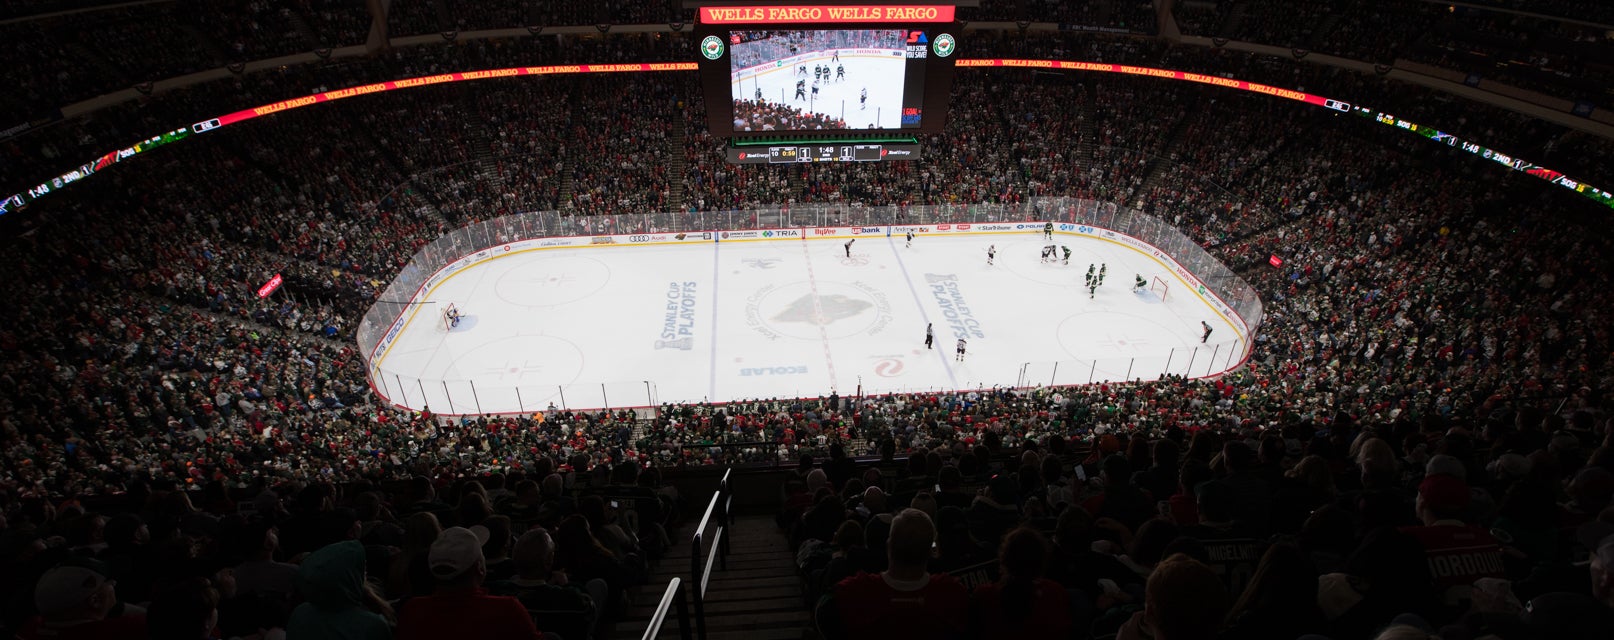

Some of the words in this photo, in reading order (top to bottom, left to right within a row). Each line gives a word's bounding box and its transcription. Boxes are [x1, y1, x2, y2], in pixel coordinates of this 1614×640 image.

[709, 8, 765, 21] WELLS
[768, 8, 822, 20] FARGO
[827, 8, 883, 20] WELLS
[885, 8, 938, 20] FARGO
[461, 71, 490, 79] WELLS
[490, 69, 518, 77] FARGO
[1120, 66, 1147, 74] WELLS
[1147, 69, 1175, 77] FARGO
[393, 78, 424, 88] WELLS
[424, 75, 453, 84] FARGO
[1183, 73, 1211, 83] WELLS
[1211, 78, 1239, 87] FARGO
[324, 89, 356, 99] WELLS
[356, 84, 385, 94] FARGO
[1248, 84, 1276, 94] WELLS
[1276, 89, 1305, 100] FARGO
[253, 103, 286, 115] WELLS
[286, 96, 316, 108] FARGO
[1397, 120, 1412, 129] SOG
[1451, 137, 1456, 145] 1
[801, 148, 807, 158] 1
[819, 146, 834, 154] 1:48
[843, 147, 849, 157] 1
[1462, 141, 1480, 154] 1:48
[1492, 153, 1511, 165] 2ND
[83, 166, 89, 175] 1
[1515, 160, 1521, 168] 1
[29, 184, 50, 199] 1:48
[62, 171, 81, 184] 2ND
[1561, 177, 1579, 190] SOG
[14, 196, 22, 206] 1
[1176, 267, 1198, 288] HONDA
[678, 281, 697, 336] PLAYOFFS
[929, 284, 970, 340] PLAYOFFS
[944, 281, 973, 318] STANLEY
[964, 318, 985, 339] CUP
[661, 300, 678, 339] STANLEY
[386, 317, 405, 344] GEICO
[740, 365, 808, 377] ECOLAB
